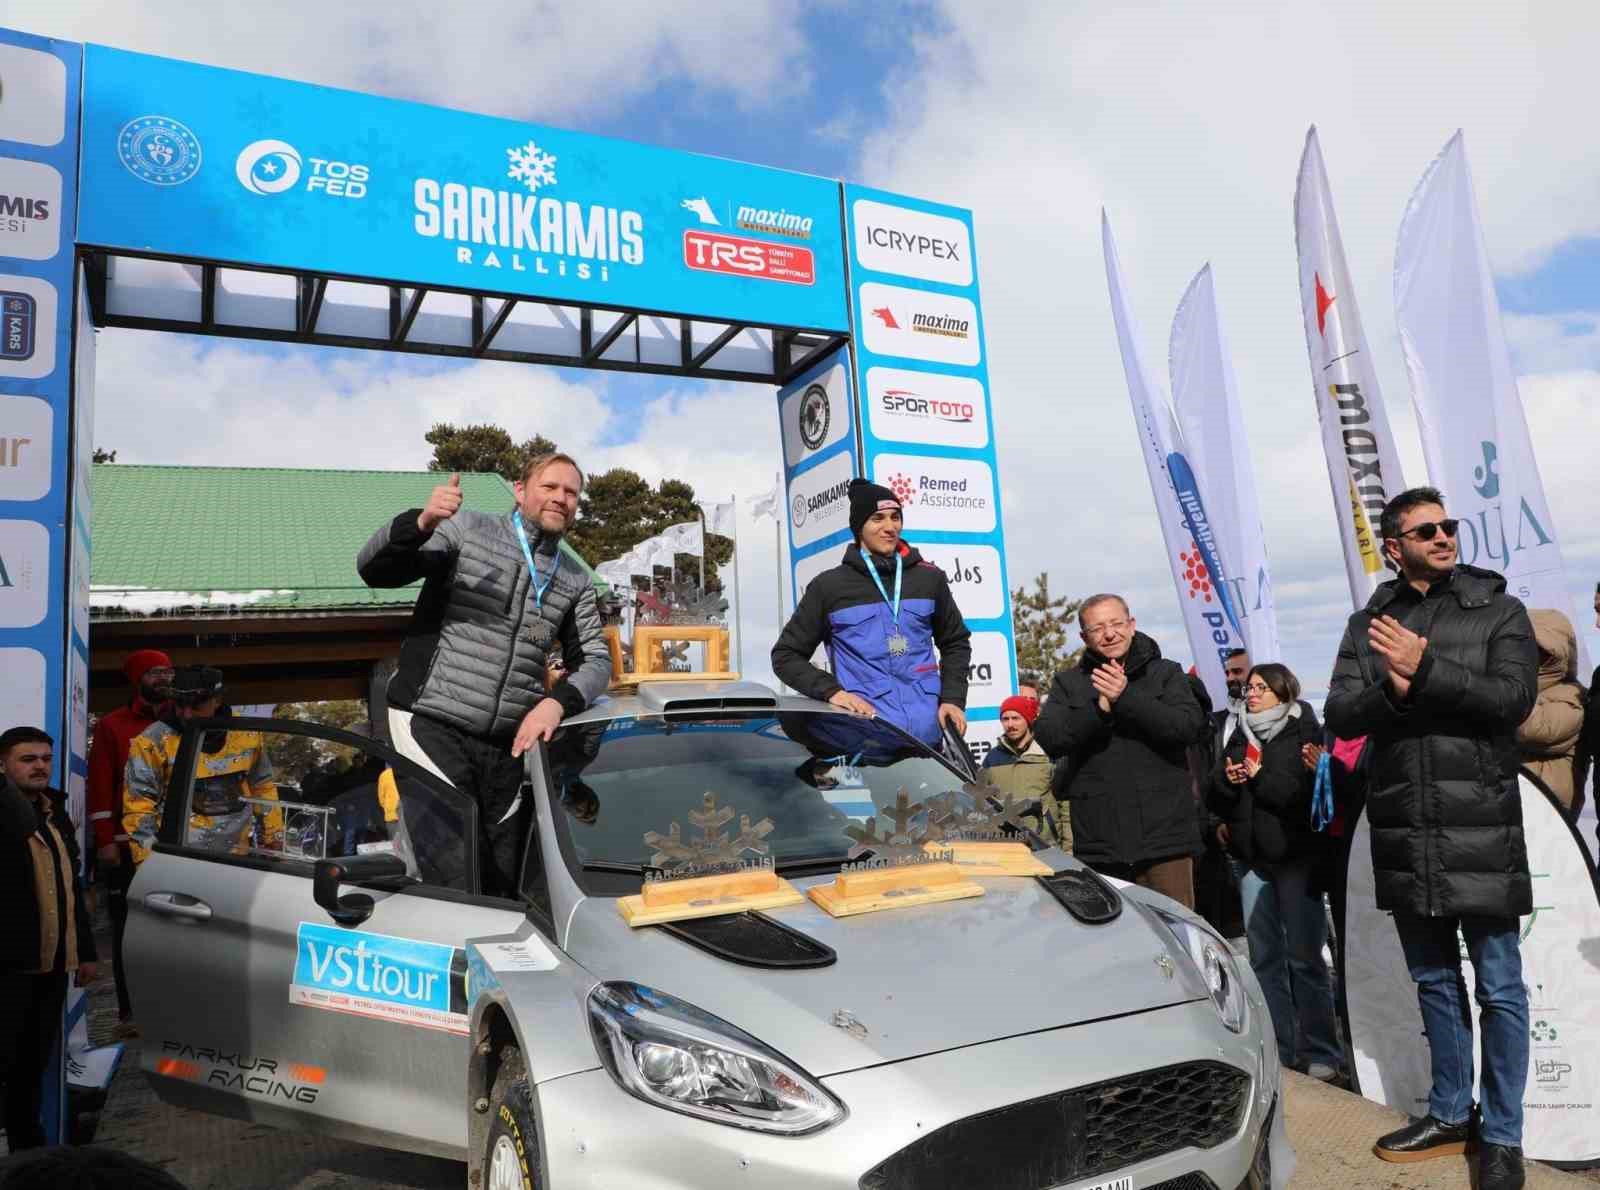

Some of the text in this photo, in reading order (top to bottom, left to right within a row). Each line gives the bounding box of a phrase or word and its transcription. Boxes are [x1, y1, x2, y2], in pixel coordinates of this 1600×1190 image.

[308, 157, 369, 183] TOS
[306, 177, 367, 199] FED
[414, 178, 644, 265] SARIKAMIS
[737, 206, 813, 231] maxima
[688, 238, 766, 271] TRS
[867, 225, 961, 262] ICRYPEX
[9, 318, 22, 350] KARS
[912, 313, 969, 332] maxima
[920, 475, 967, 492] Remed
[1336, 383, 1402, 571] maxim
[920, 493, 986, 509] Assistance
[162, 1040, 279, 1075] PARKUR
[207, 1069, 319, 1104] RACING
